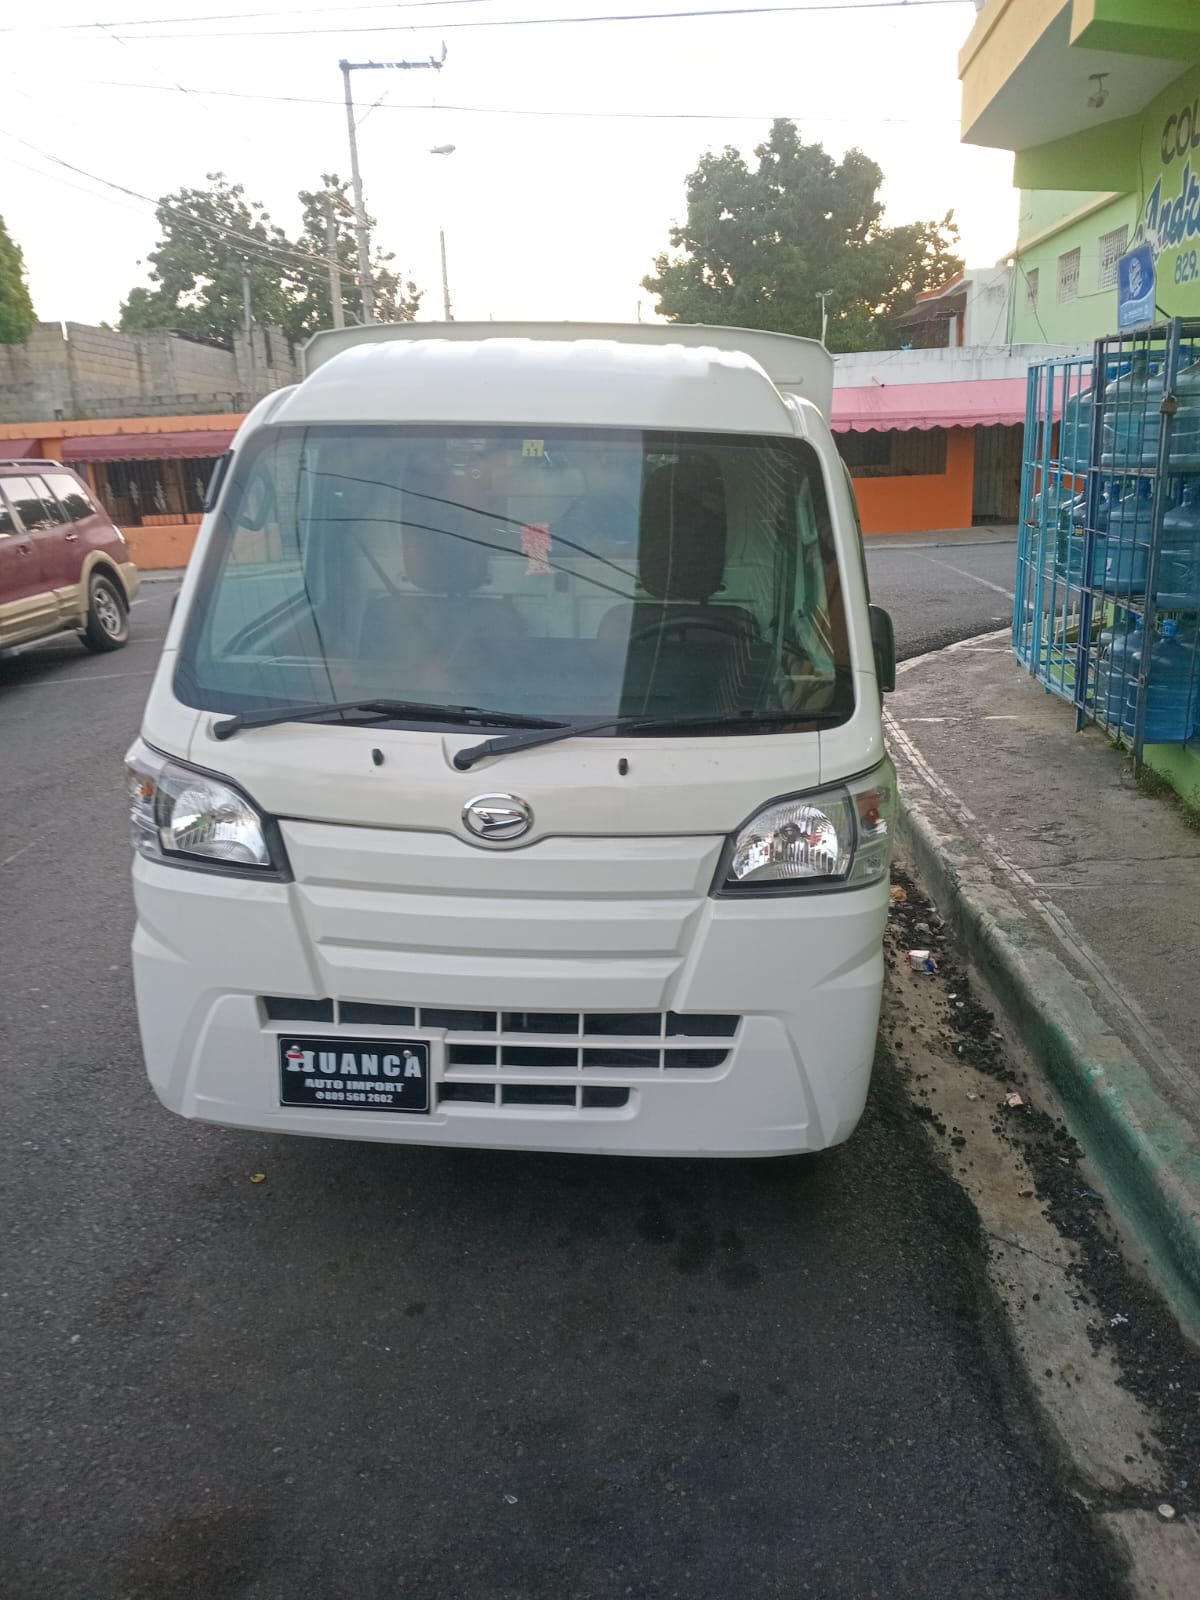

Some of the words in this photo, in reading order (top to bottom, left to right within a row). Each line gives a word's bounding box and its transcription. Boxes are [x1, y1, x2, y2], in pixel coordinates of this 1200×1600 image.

[284, 1048, 422, 1078] HUANCA
[304, 1078, 344, 1090] AUTO
[346, 1080, 404, 1092] IMPORT
